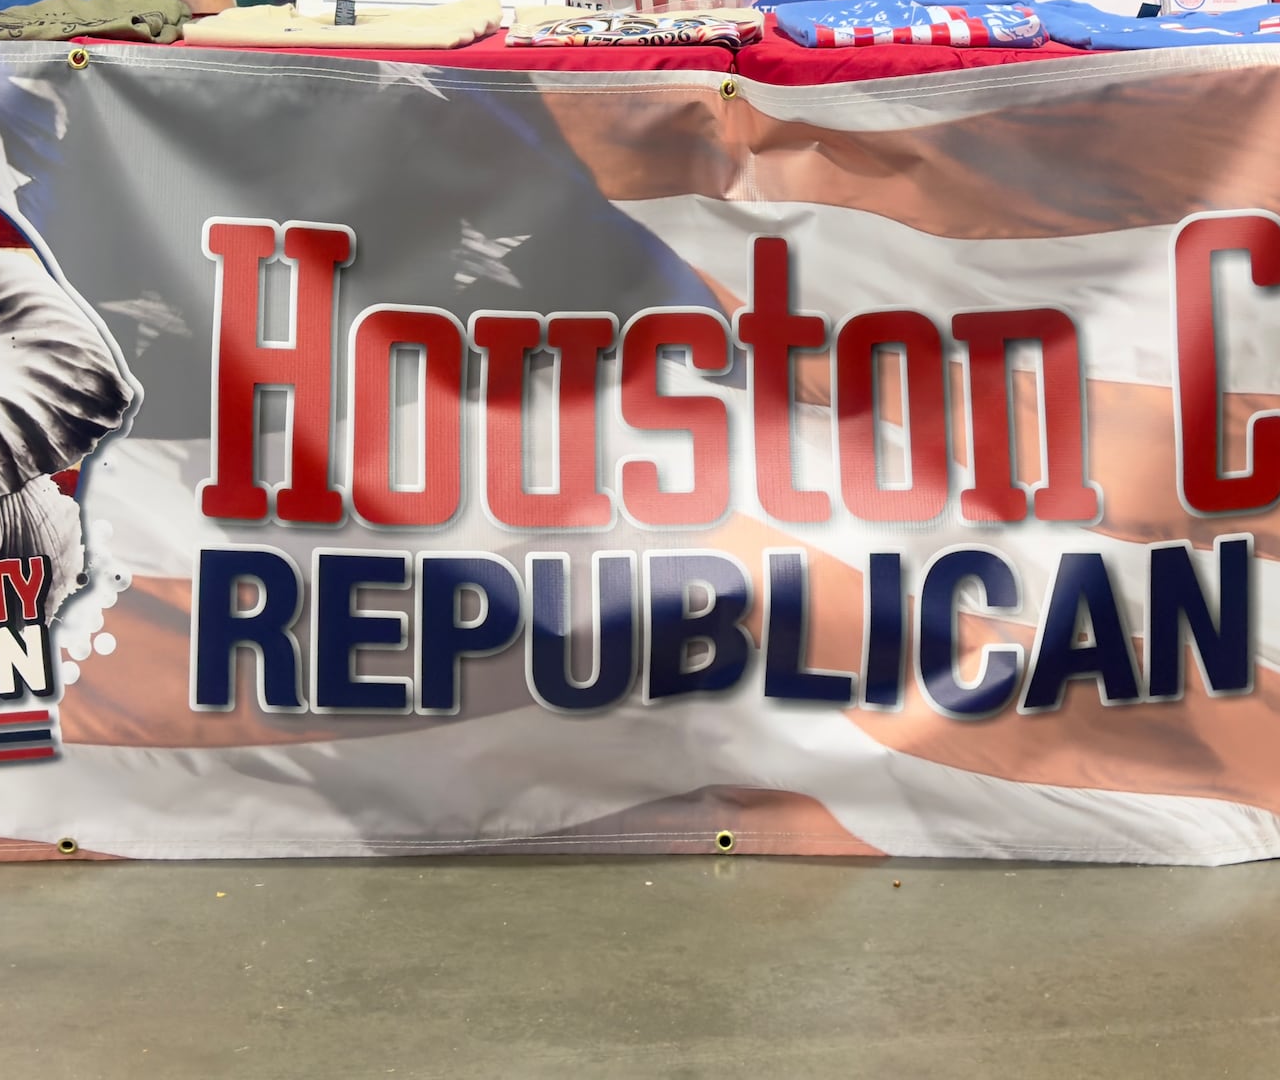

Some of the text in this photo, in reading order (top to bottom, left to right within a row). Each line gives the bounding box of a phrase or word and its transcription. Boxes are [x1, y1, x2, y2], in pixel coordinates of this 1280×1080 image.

[638, 31, 691, 47] 2026
[199, 217, 1102, 525] Houston
[192, 535, 1255, 716] REPUBLICAN
